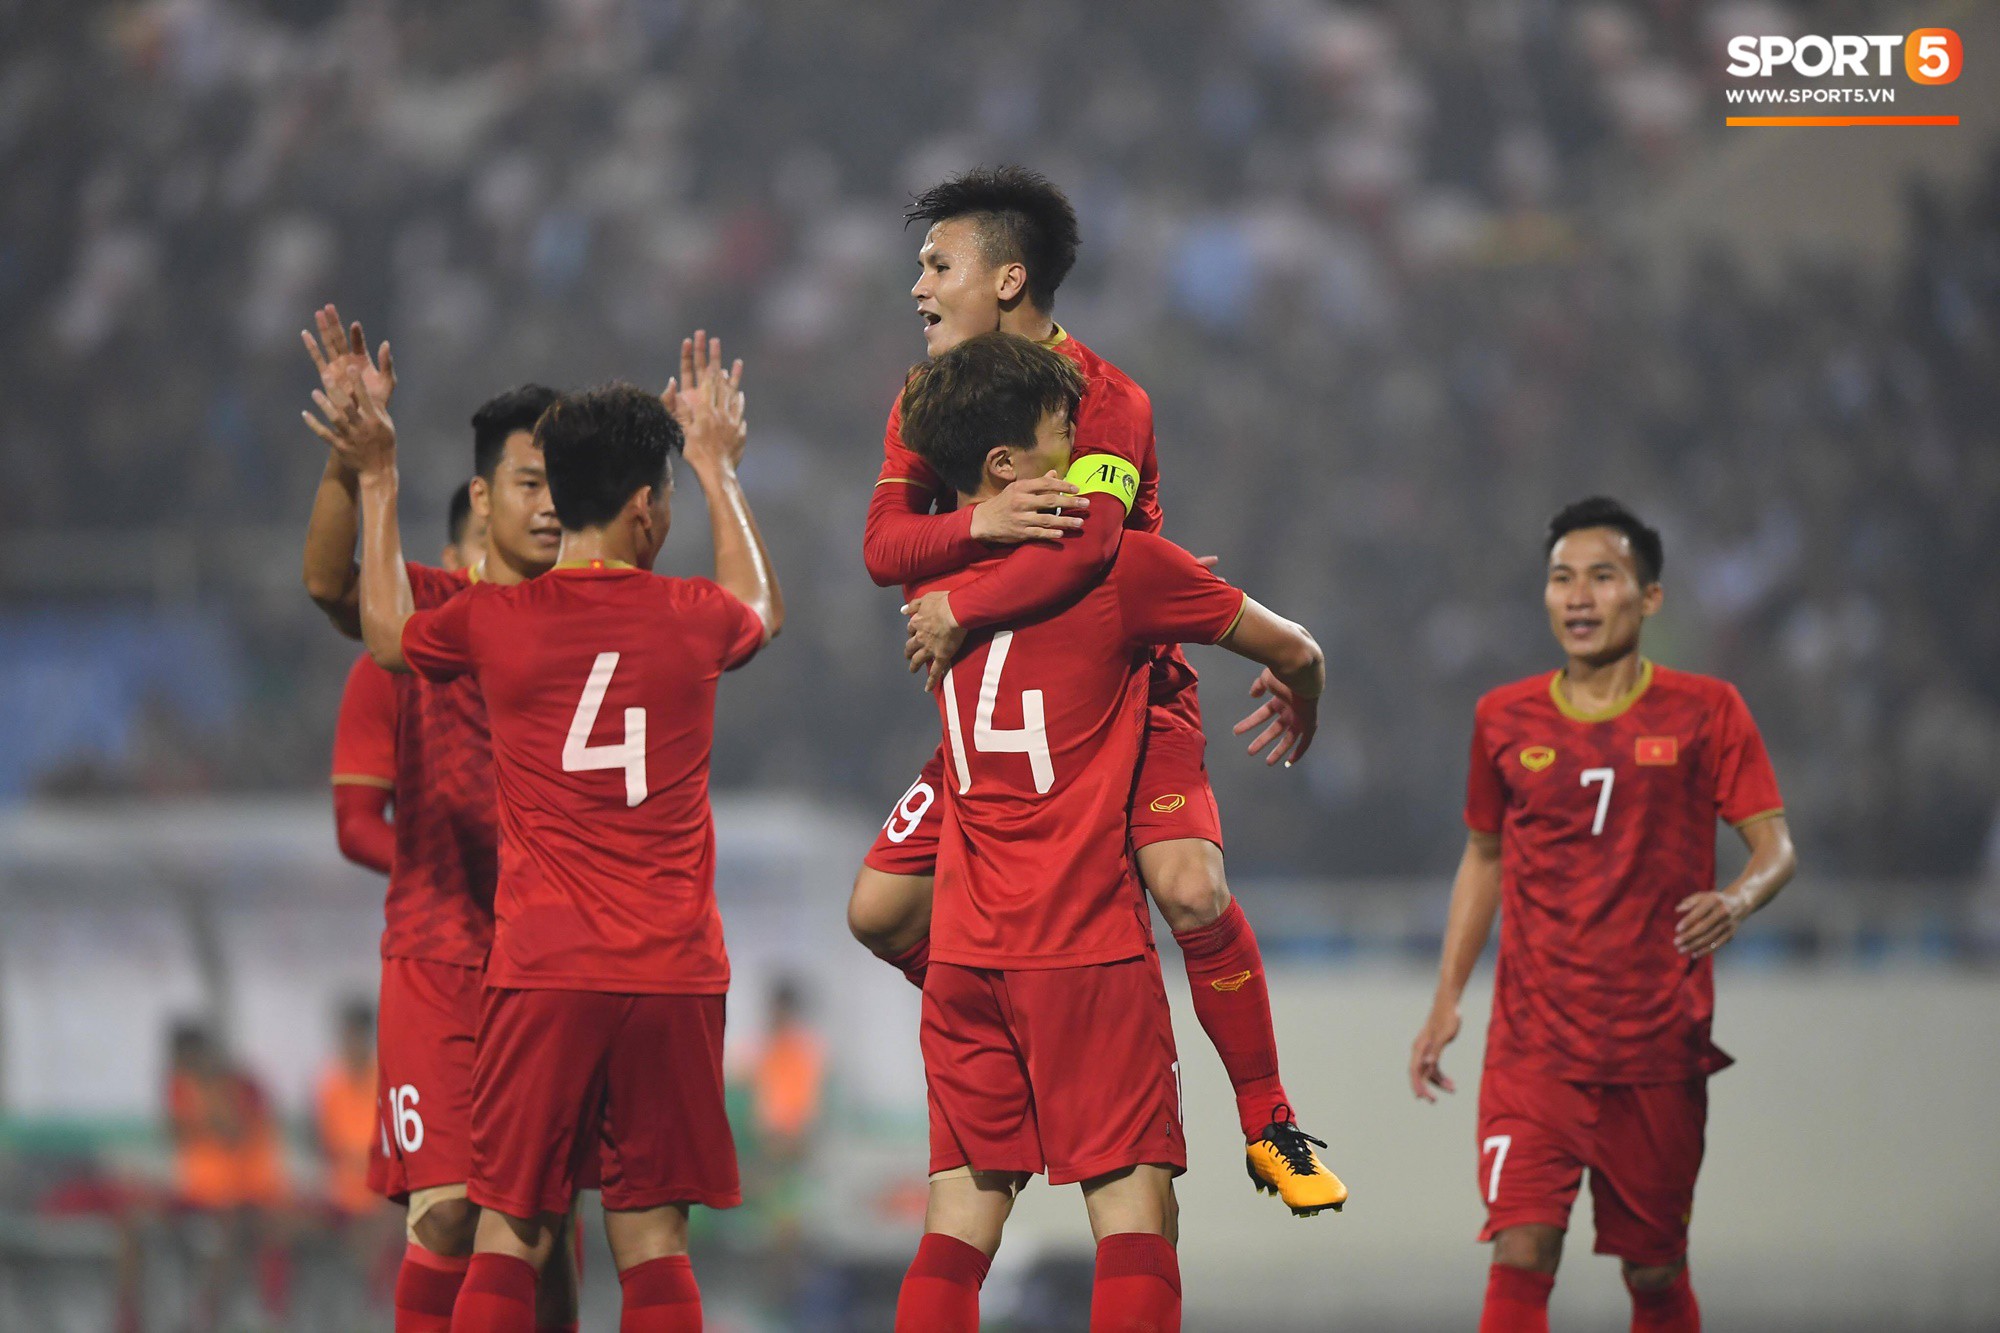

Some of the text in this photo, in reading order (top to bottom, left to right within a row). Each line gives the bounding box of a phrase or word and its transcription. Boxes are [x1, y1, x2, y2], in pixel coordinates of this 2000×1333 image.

[561, 651, 648, 808] 4
[942, 629, 1056, 795] 14
[1580, 767, 1615, 836] 7
[388, 1083, 425, 1154] 16
[1482, 1134, 1512, 1203] 7
